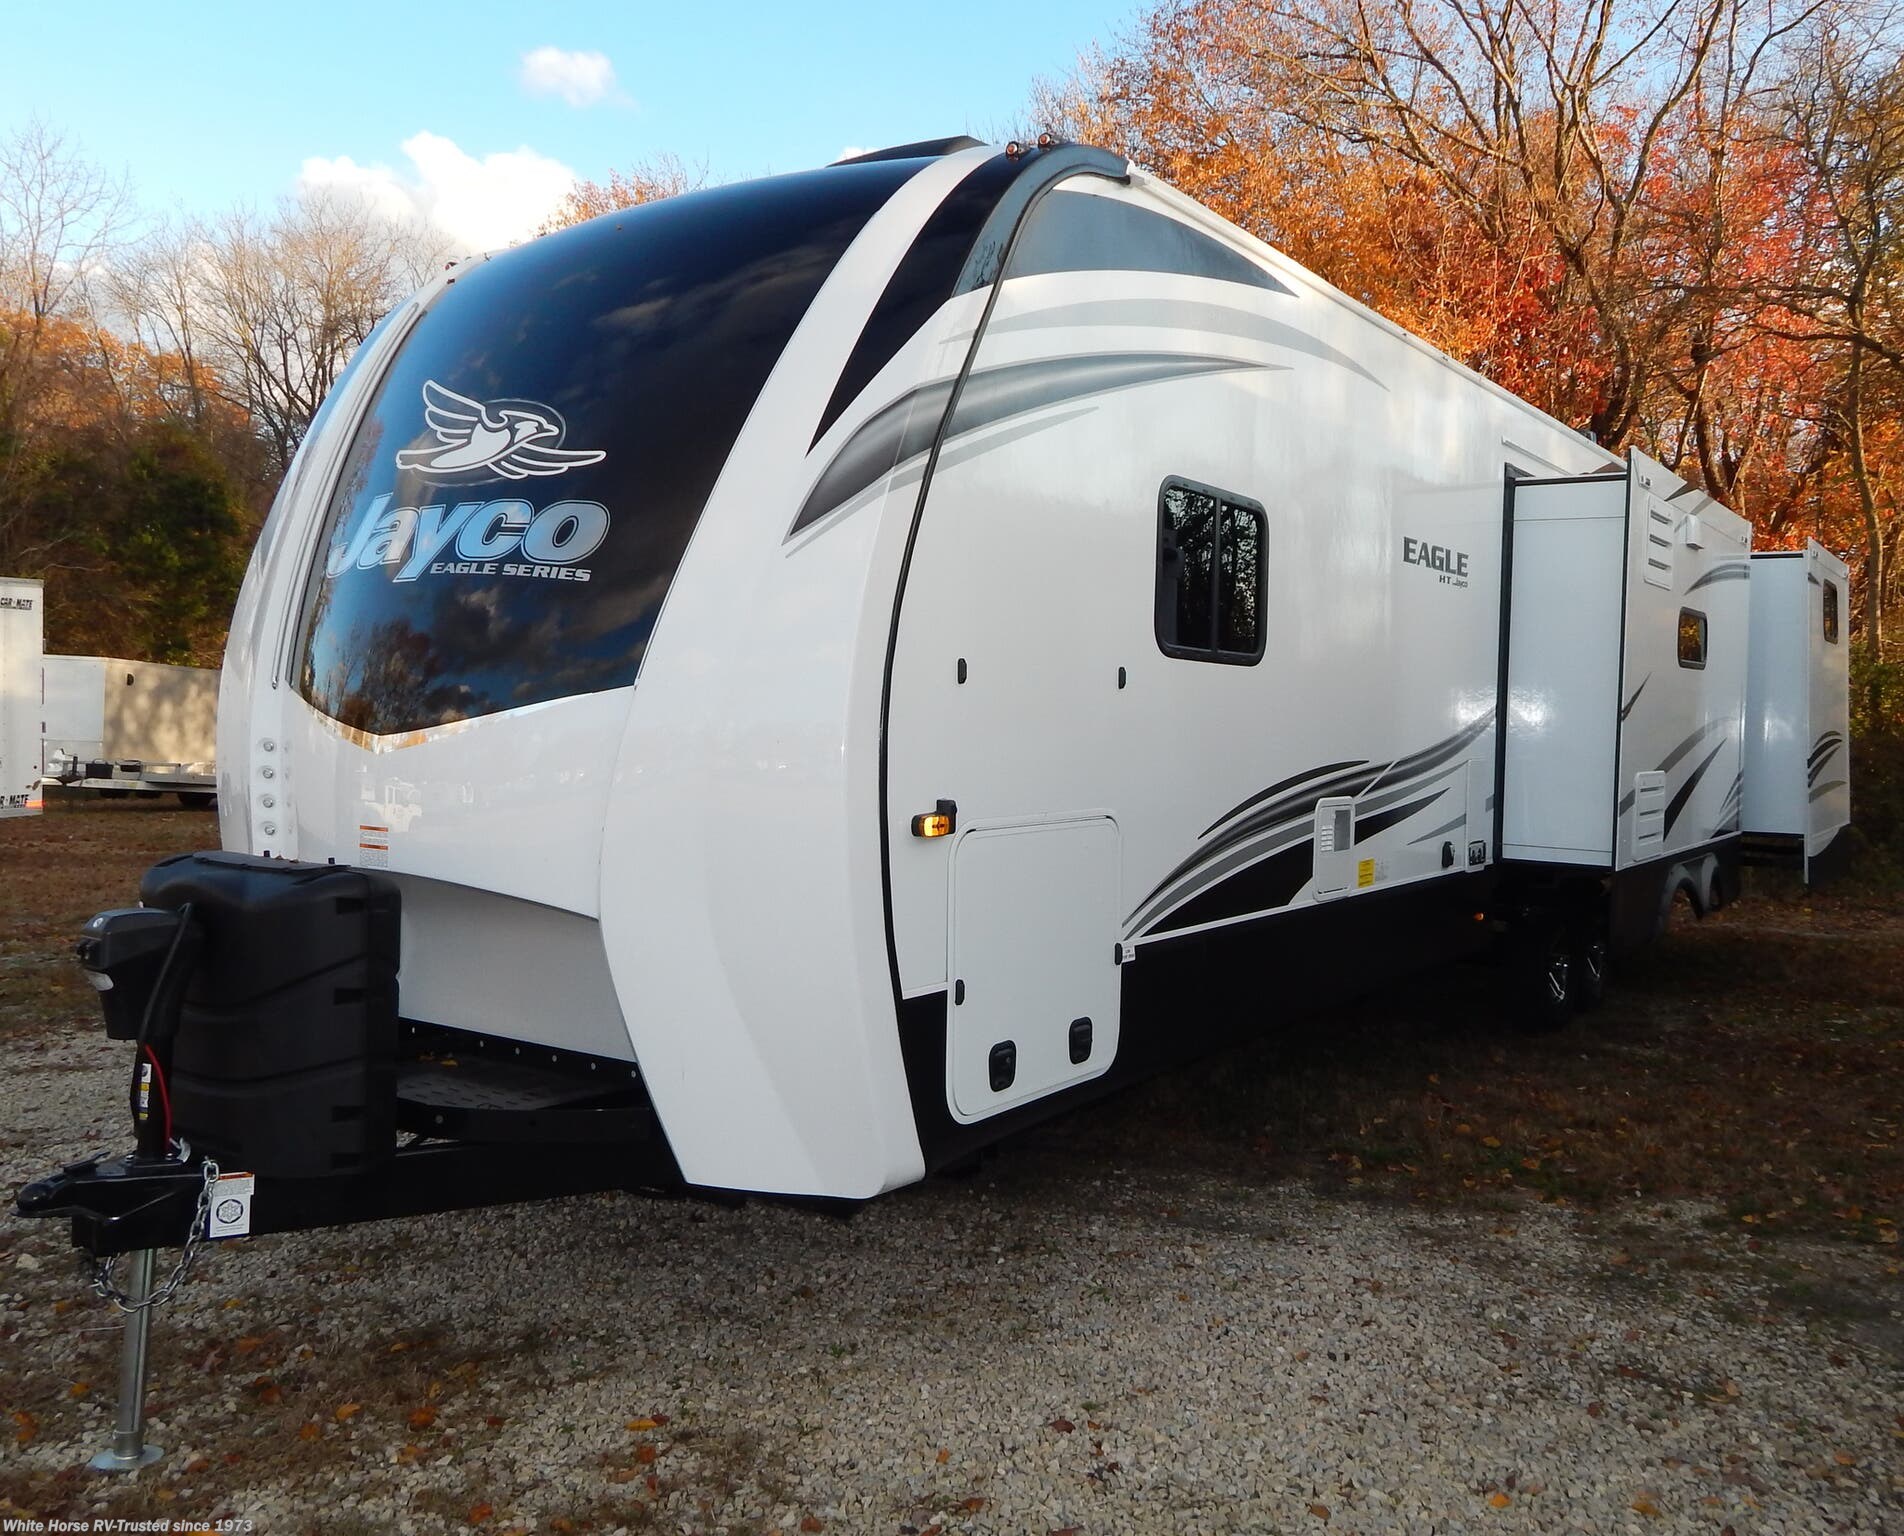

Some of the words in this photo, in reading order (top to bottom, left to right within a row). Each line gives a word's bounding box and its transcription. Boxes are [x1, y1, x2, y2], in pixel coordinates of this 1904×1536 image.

[327, 492, 610, 582] Jayco
[429, 562, 497, 576] EAGLE
[502, 563, 592, 581] SERIES
[1403, 536, 1469, 577] EAGLE
[1439, 574, 1452, 585] HT
